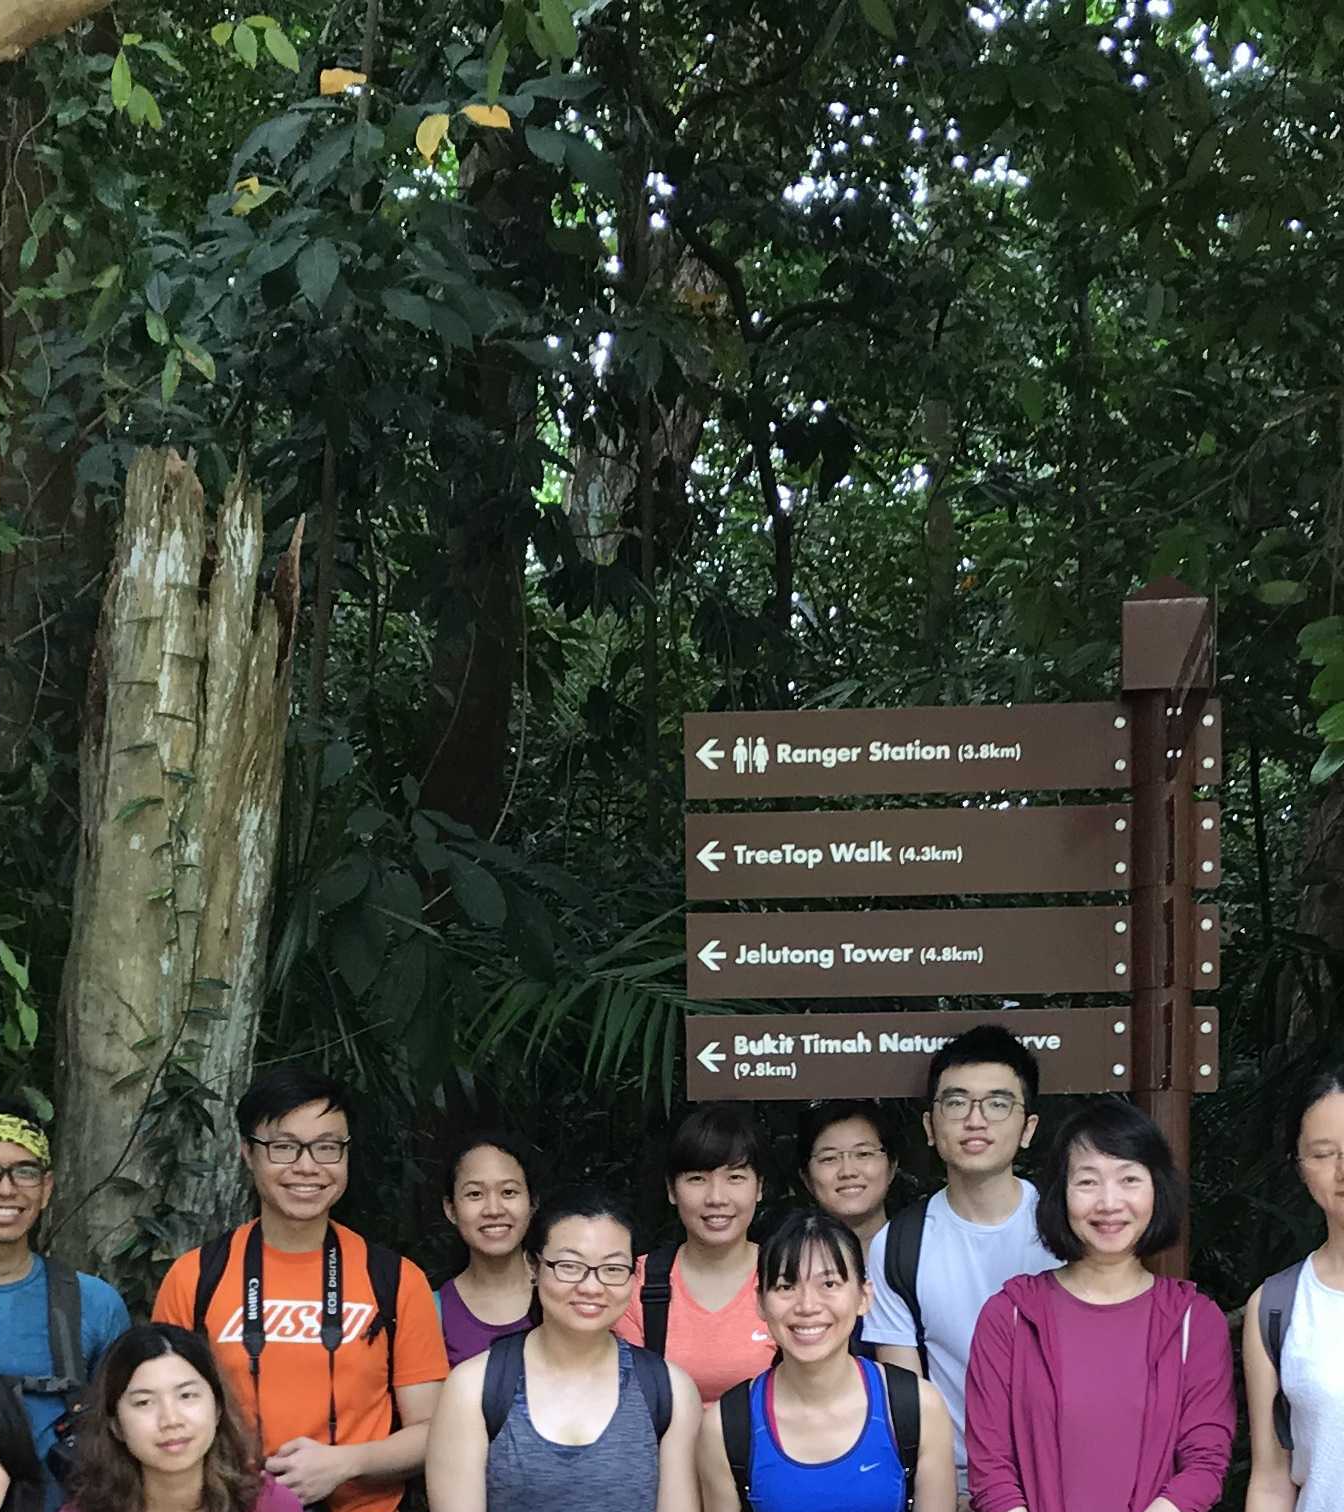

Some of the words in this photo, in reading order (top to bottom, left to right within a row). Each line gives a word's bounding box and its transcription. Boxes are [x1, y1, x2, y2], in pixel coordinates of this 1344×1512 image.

[776, 743, 862, 768] Ranger
[868, 739, 951, 763] Station
[958, 743, 1022, 763] (3.8km)
[733, 843, 824, 869] TreeTop
[829, 840, 892, 864] Walk
[899, 845, 963, 865] (4.3km)
[734, 942, 835, 969] Jelutong
[840, 943, 914, 964] Tower
[920, 945, 984, 966] (4.8km)
[734, 1032, 795, 1056] Bukit
[801, 1031, 872, 1055] Timah
[878, 1032, 955, 1053] Natur
[733, 1061, 797, 1081] (9.8km)
[328, 1247, 337, 1288] DIGITAL
[247, 1277, 260, 1320] Canon
[327, 1291, 338, 1315] EOS
